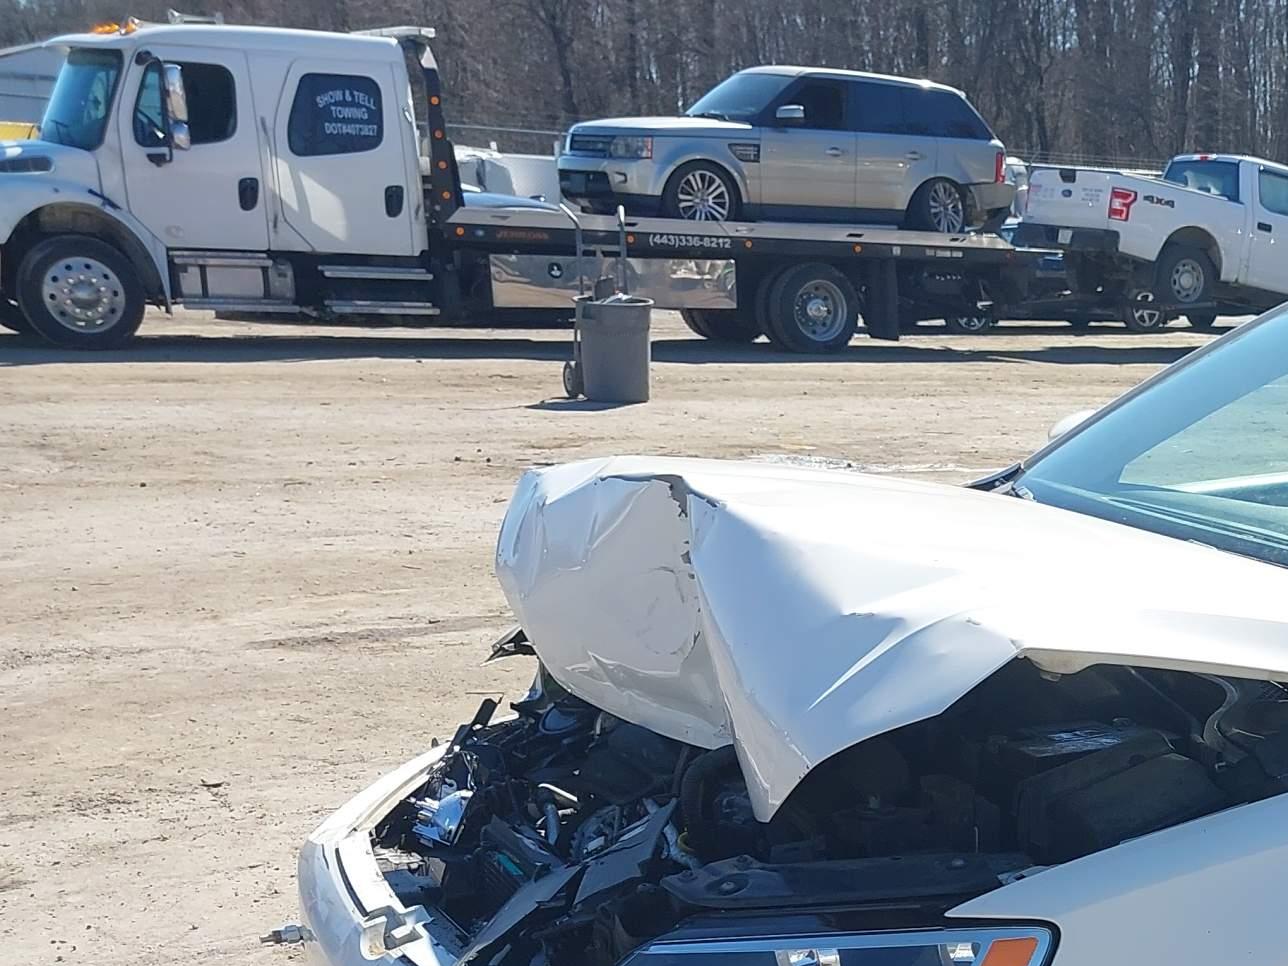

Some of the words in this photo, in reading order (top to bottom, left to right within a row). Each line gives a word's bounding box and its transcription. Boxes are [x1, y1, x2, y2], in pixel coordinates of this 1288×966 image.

[316, 90, 343, 108] SHOW
[345, 89, 352, 102] &
[353, 90, 377, 110] TELL
[331, 105, 368, 120] TOWING
